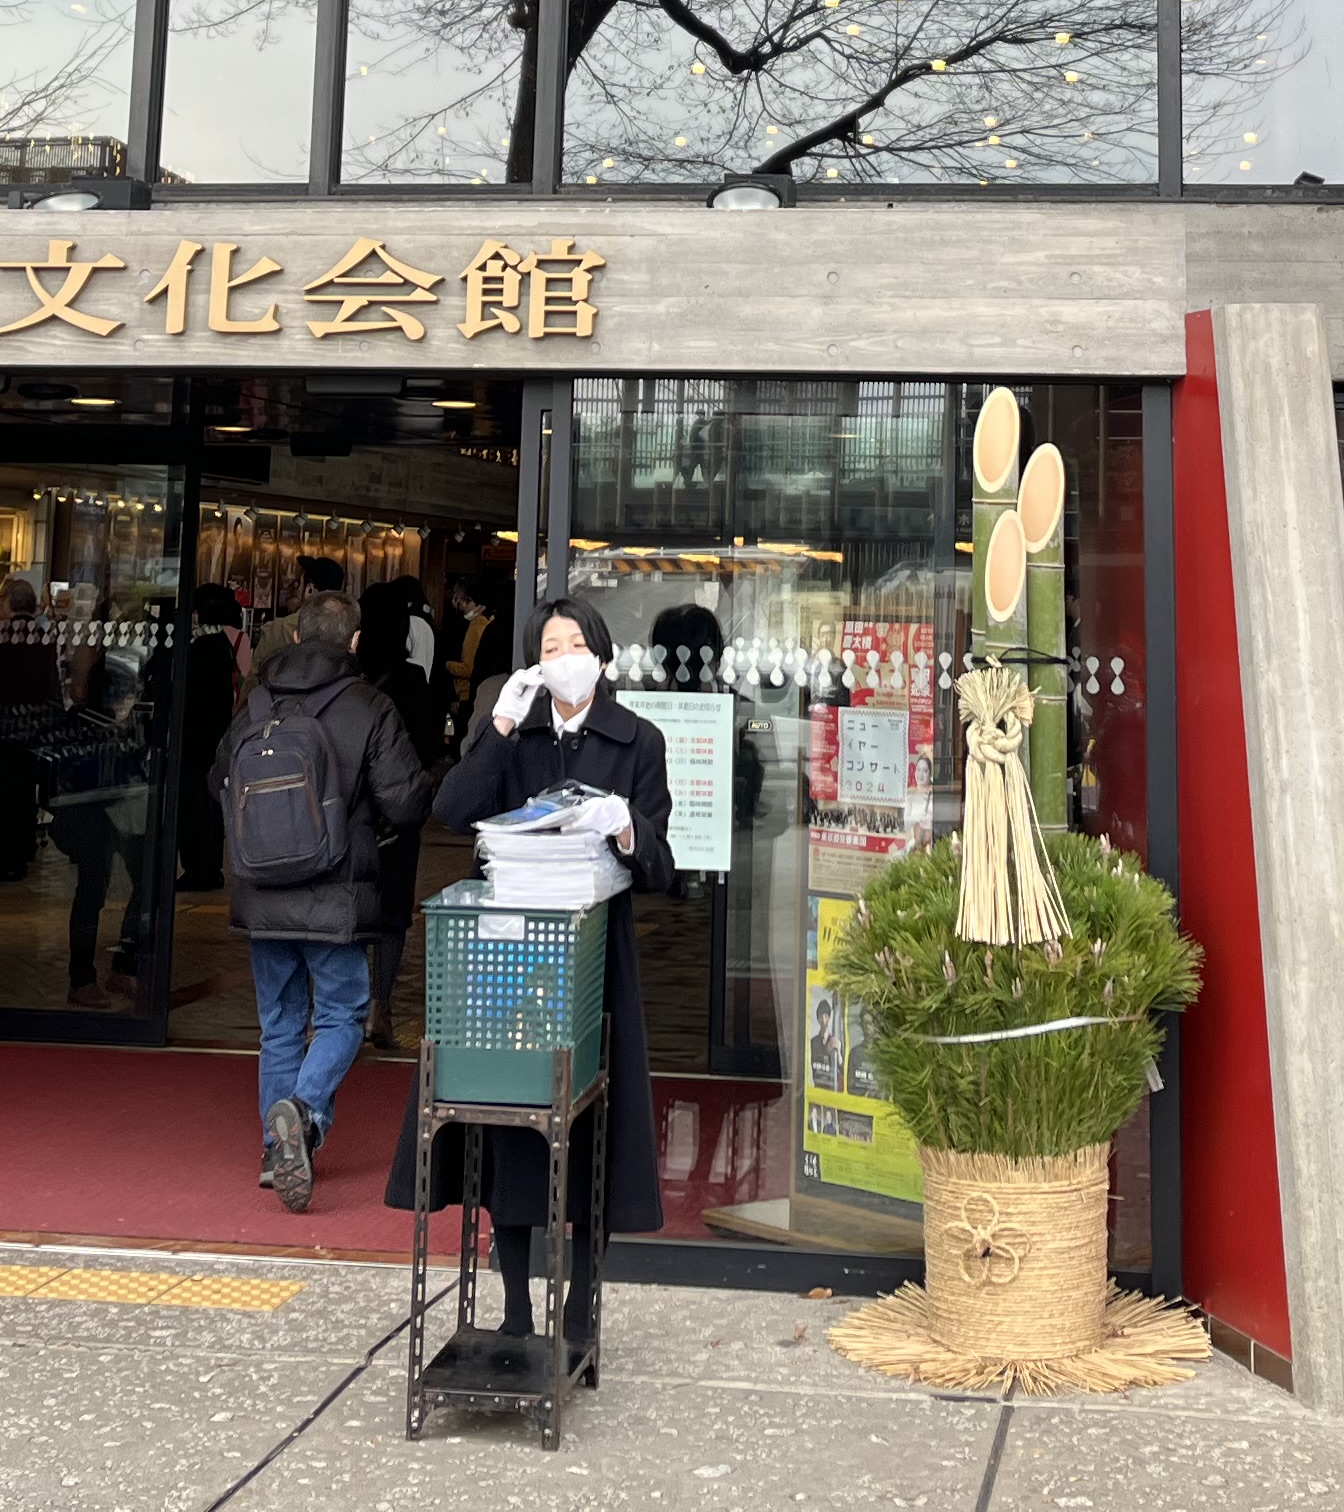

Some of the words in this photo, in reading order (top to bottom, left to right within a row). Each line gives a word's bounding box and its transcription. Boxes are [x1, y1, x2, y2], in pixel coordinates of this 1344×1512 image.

[846, 719, 879, 731] ニュー
[847, 738, 879, 752] イヤー
[846, 760, 901, 774] コンサート
[846, 779, 886, 793] 2024
